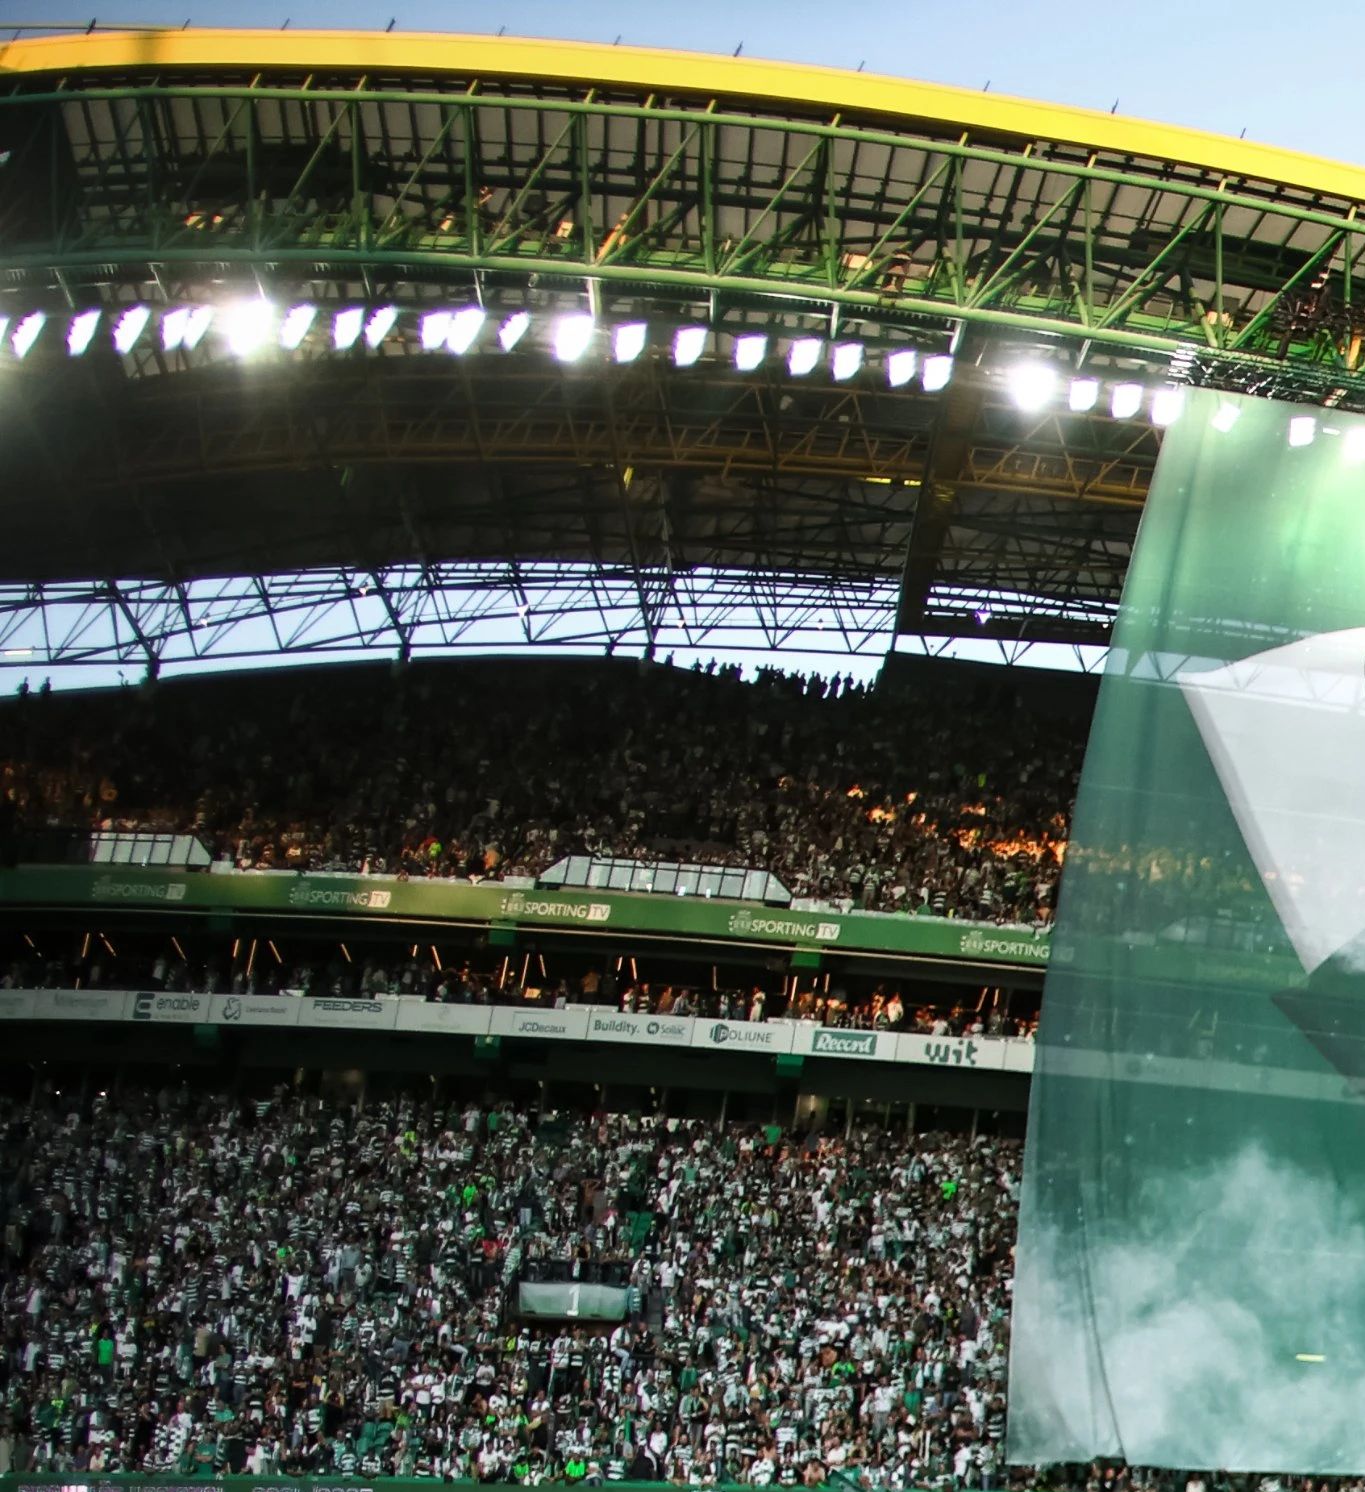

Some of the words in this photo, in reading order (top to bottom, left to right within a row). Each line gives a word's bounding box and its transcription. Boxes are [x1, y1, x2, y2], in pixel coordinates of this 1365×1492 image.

[112, 882, 165, 898] SPORTING
[309, 890, 368, 906] SPORTING
[368, 891, 391, 907] TV
[524, 901, 587, 919] SPORTING
[587, 904, 611, 921] TV
[750, 920, 815, 938] SPORTING
[815, 923, 841, 940] TV
[983, 940, 1049, 959] SPORTING
[156, 997, 200, 1011] enable
[312, 1000, 383, 1013] FEEDERS
[518, 1021, 567, 1034] JCDecaux
[816, 1032, 875, 1054] Record
